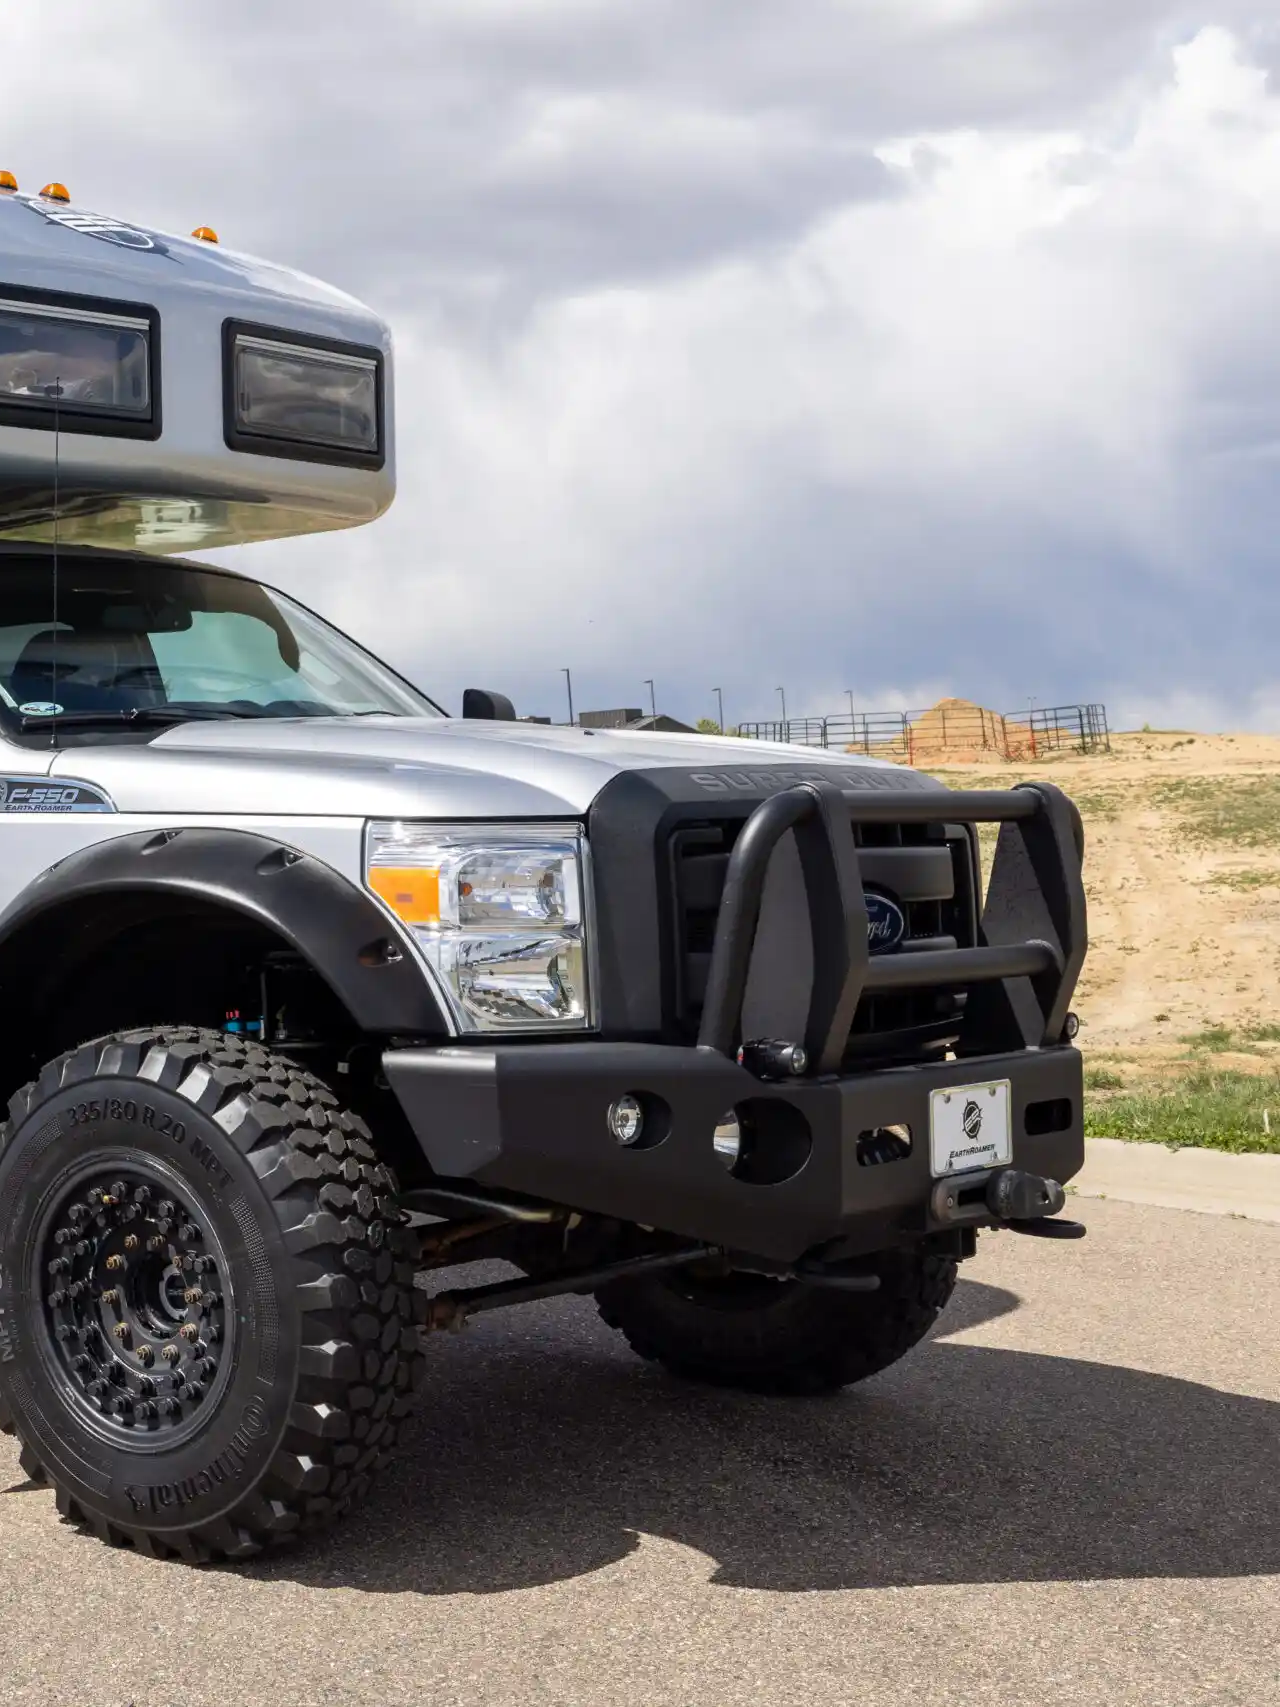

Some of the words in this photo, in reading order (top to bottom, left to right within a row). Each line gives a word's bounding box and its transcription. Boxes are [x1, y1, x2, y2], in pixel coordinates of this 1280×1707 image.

[7, 788, 79, 804] F-550
[66, 1098, 138, 1128] 335/80
[189, 1136, 236, 1188] MPT
